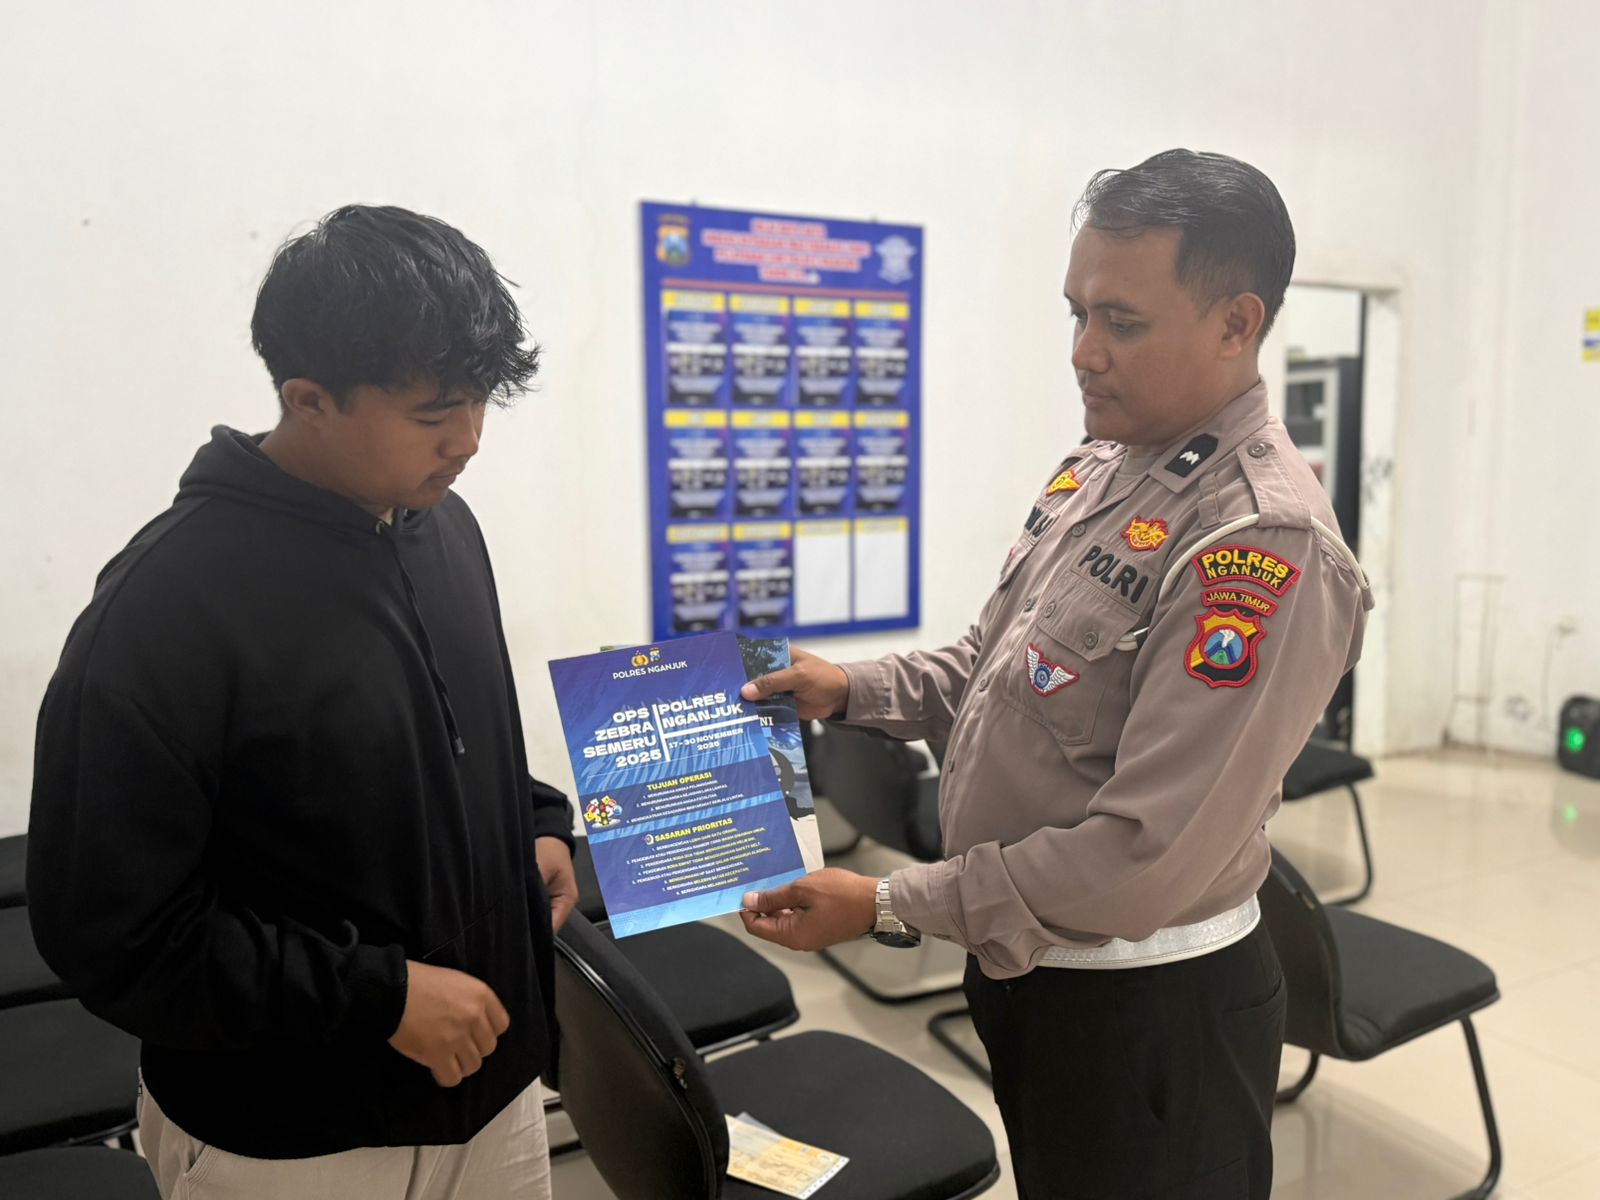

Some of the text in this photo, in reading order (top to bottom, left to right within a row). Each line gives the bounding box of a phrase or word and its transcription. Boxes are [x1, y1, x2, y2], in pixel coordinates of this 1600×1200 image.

[1202, 549, 1288, 578] POLRES
[1078, 545, 1148, 603] POLRI
[1206, 564, 1281, 588] NGANJUK
[1207, 592, 1270, 611] JAWA TIMUR
[612, 661, 688, 680] POLRES NGANJUK
[659, 693, 726, 715] POLRES
[613, 708, 649, 723] OPS
[662, 703, 743, 728] NGANJUK
[595, 722, 654, 741] ZEBRA
[696, 728, 743, 743] NOVEMBER
[583, 735, 657, 758] SEMERU
[616, 749, 661, 767] 2025
[647, 779, 678, 791] TUJUAN
[679, 772, 712, 784] OPERASI
[655, 828, 690, 842] SASARAN
[692, 818, 733, 833] PRIORITAS
